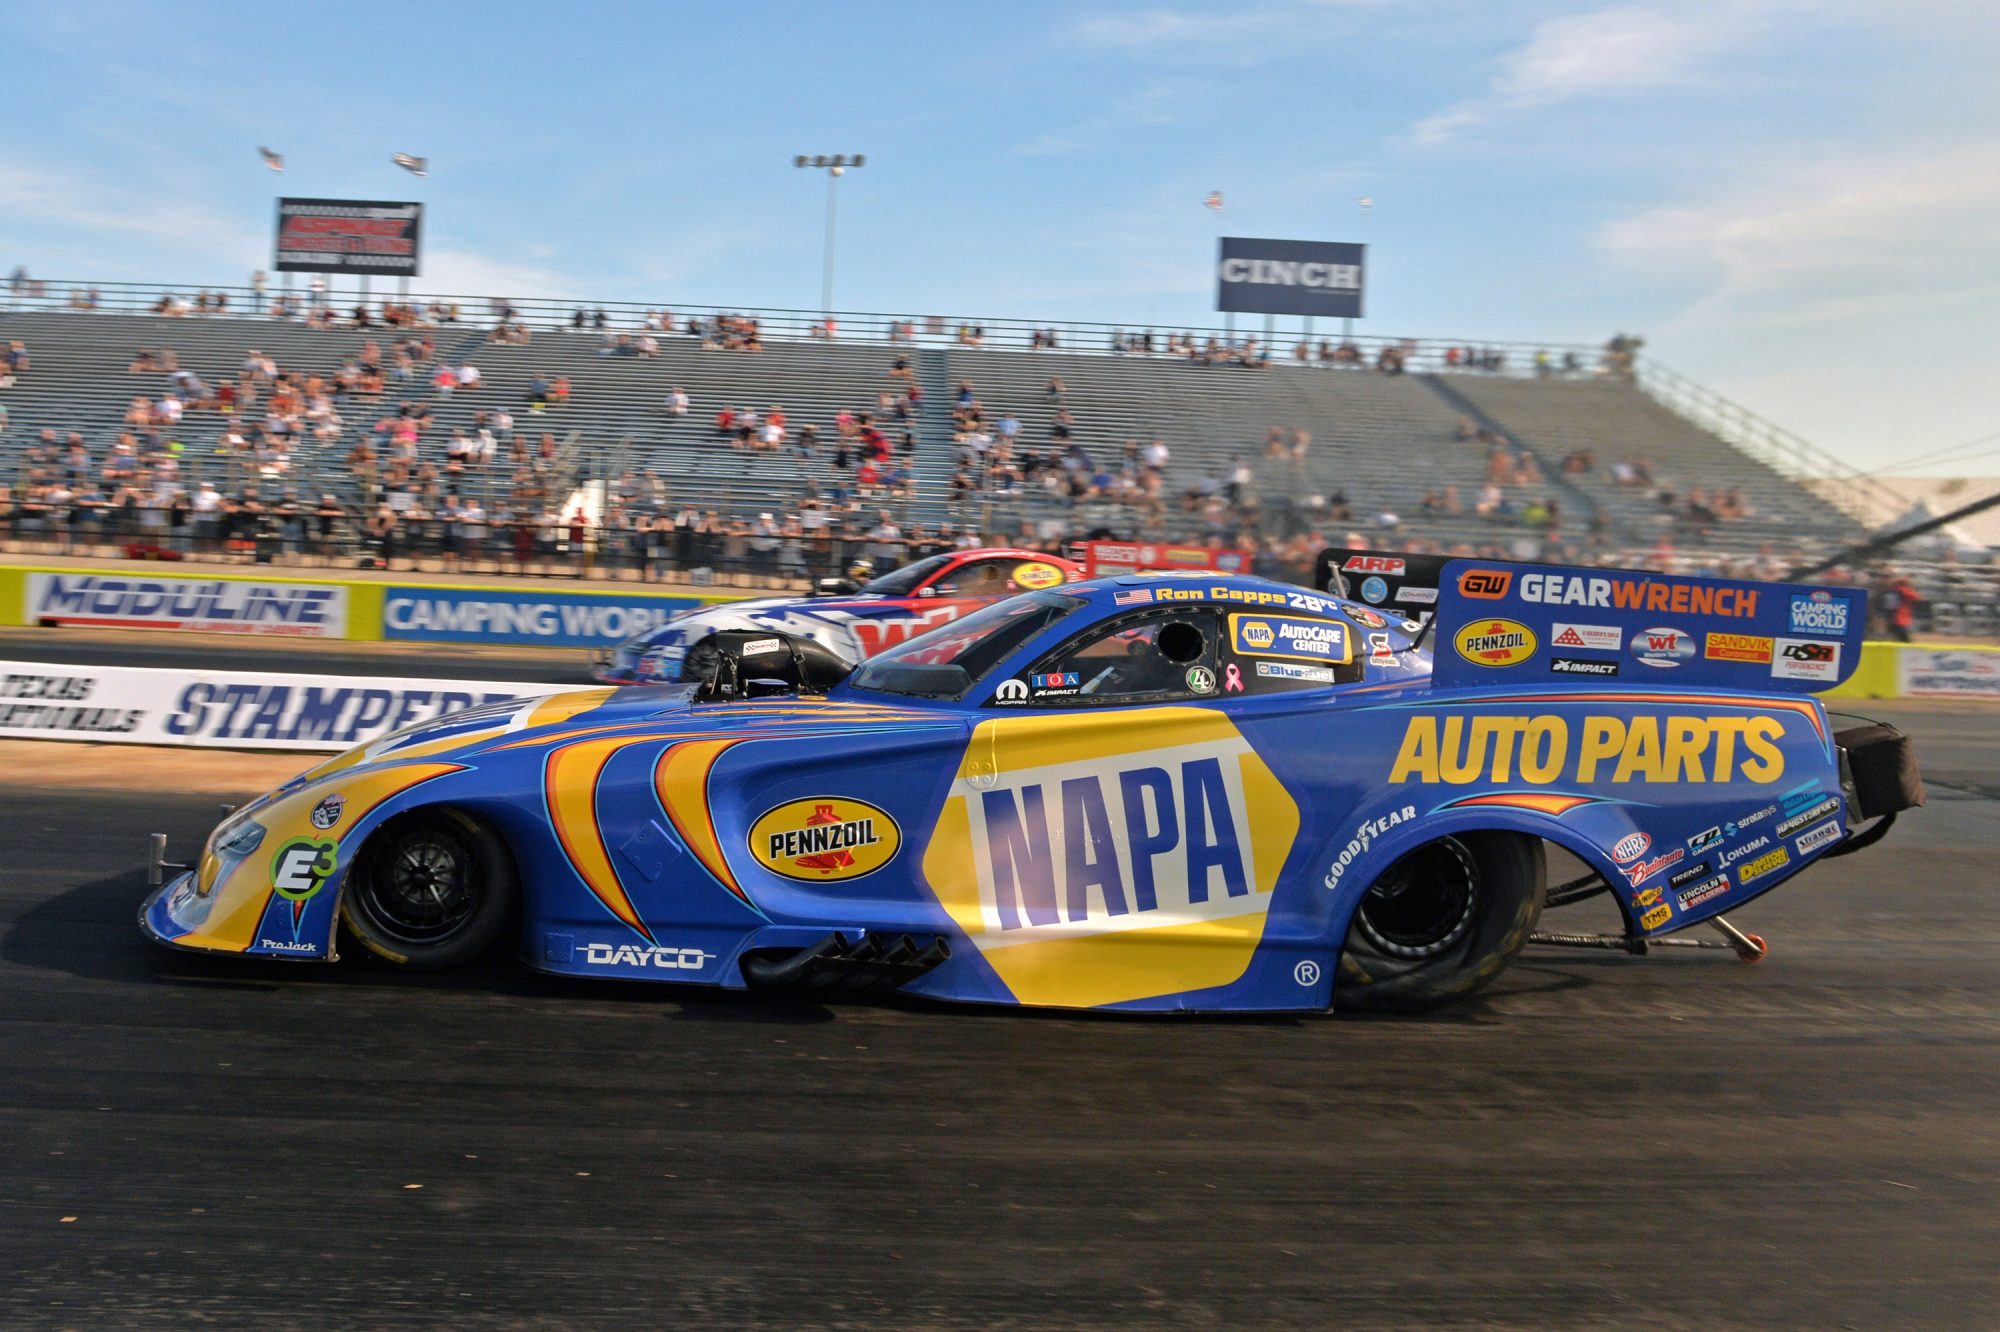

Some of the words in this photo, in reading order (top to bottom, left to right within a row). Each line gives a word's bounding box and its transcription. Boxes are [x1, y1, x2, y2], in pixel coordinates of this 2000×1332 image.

[1221, 257, 1362, 289] CINCH
[1343, 555, 1404, 573] ARP
[1464, 575, 1506, 594] GW
[1155, 588, 1204, 600] Ron
[1210, 587, 1287, 605] Capps
[1519, 573, 1757, 618] GEARWRENCH
[383, 598, 559, 635] CAMPING
[1791, 600, 1847, 615] CAMPING
[1791, 612, 1847, 629] WORLD
[1247, 628, 1270, 641] NAPA
[1466, 632, 1526, 653] PENNZOIL
[1647, 633, 1677, 651] wt
[1708, 634, 1771, 650] SANDVIK
[1292, 639, 1330, 654] CENTER
[1570, 663, 1617, 674] IMPACT
[1387, 714, 1569, 785] AUTO
[1576, 714, 1787, 785] PARTS
[1737, 804, 1777, 829] stratasys
[769, 818, 879, 860] PENNZOIL
[981, 756, 1249, 931] NAPA
[1324, 805, 1417, 890] GOODYEAR
[1616, 836, 1648, 860] NHRA
[1670, 864, 1705, 884] TREND
[1678, 878, 1720, 904] LINCOLN
[1644, 907, 1668, 924] TMS
[587, 943, 705, 969] DAYCO
